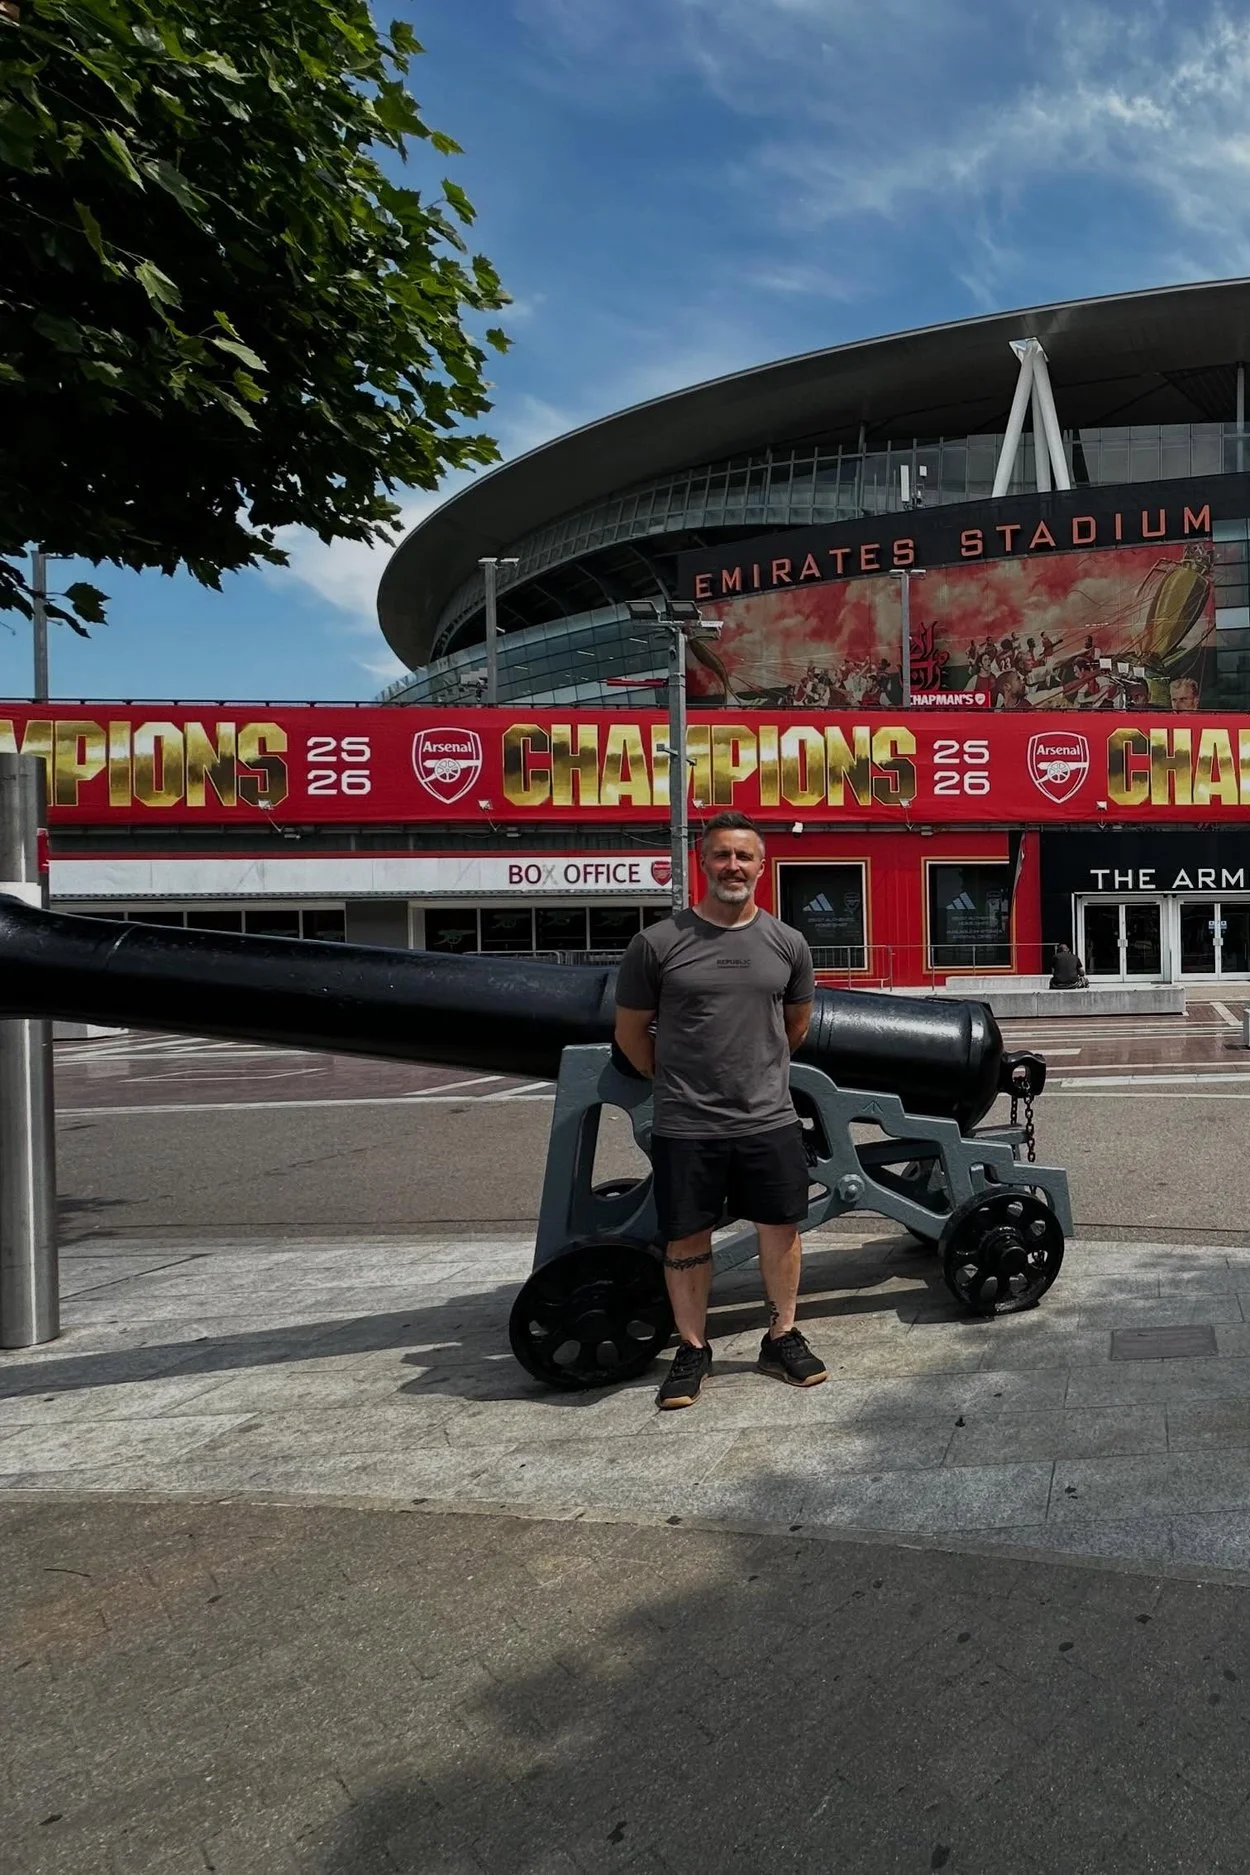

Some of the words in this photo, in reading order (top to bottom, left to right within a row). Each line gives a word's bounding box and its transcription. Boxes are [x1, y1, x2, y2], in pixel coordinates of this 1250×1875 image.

[695, 538, 915, 599] EMIRATES
[960, 504, 1211, 557] STADIUM
[307, 736, 371, 762] 25
[422, 741, 472, 753] Arsenal
[933, 740, 989, 764] 25
[1036, 744, 1080, 755] Arsenal
[502, 723, 917, 807] CHAMPIONS
[307, 770, 371, 796] 26
[933, 770, 989, 796] 26
[508, 864, 558, 884] BOX
[564, 863, 641, 884] OFFICE
[1090, 868, 1156, 889] THE
